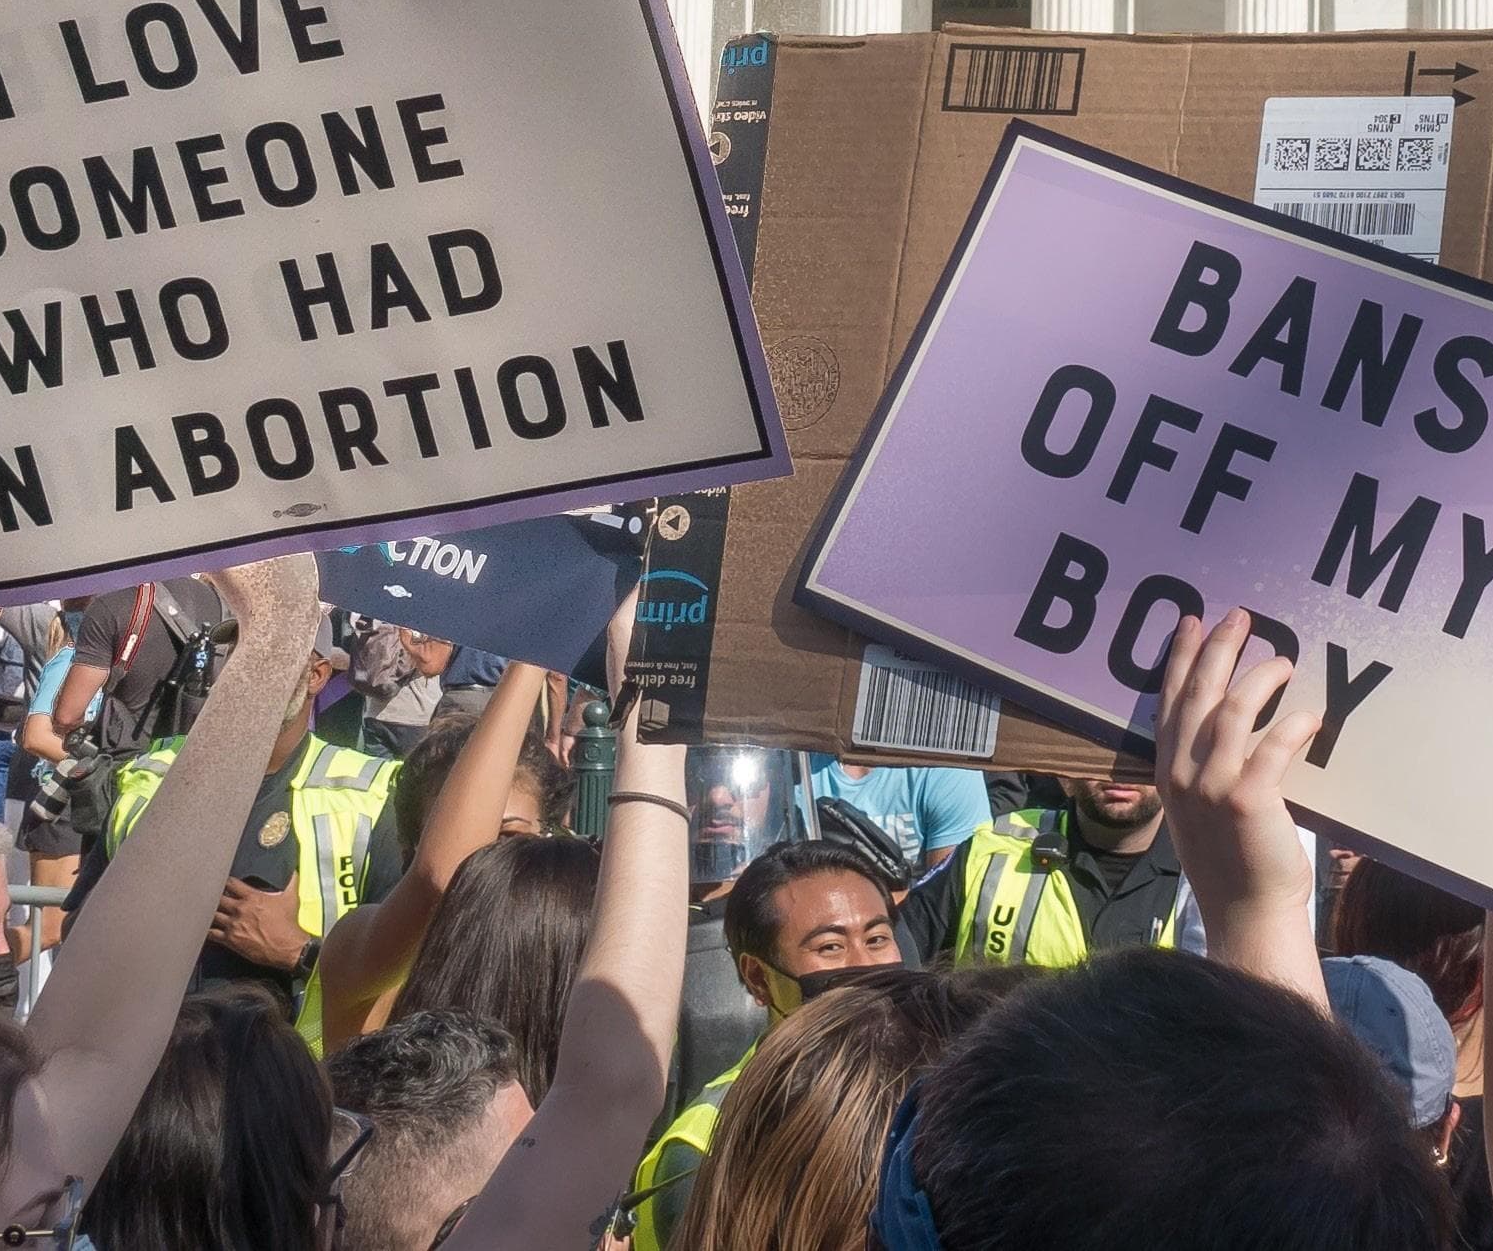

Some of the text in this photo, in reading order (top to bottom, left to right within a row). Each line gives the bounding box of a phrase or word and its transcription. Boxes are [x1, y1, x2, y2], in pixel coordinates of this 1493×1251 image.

[279, 228, 503, 342] HAD
[114, 340, 646, 512] ABORTION
[1020, 363, 1278, 535] OFF
[387, 536, 488, 584] CTION
[669, 674, 697, 689] free
[988, 904, 1016, 954] US
